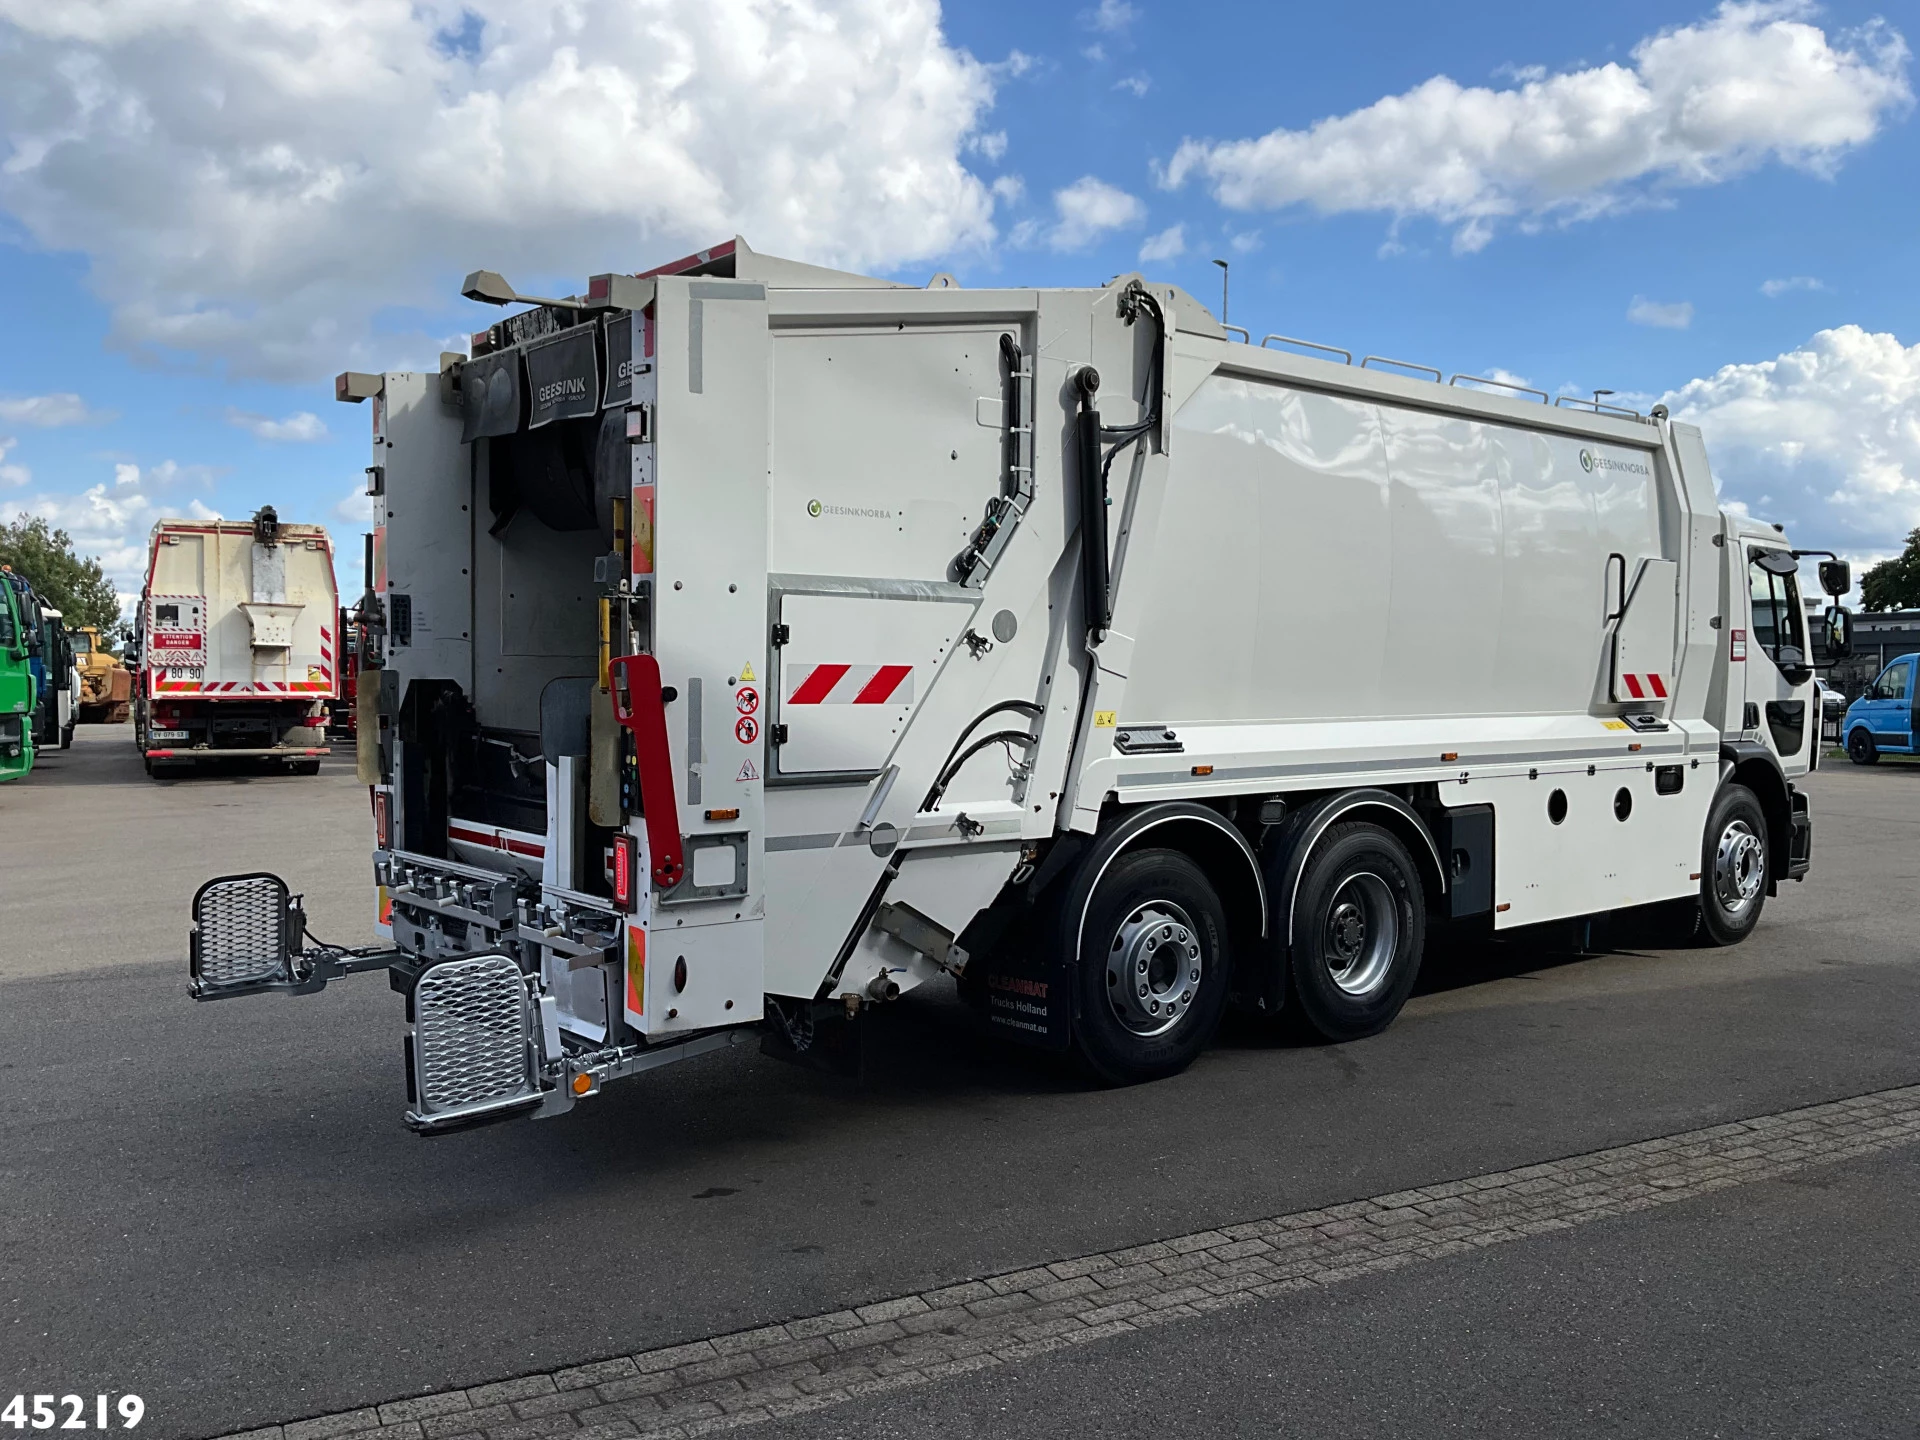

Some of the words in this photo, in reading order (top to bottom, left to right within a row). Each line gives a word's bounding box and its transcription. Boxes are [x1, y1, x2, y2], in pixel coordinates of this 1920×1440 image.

[540, 377, 586, 402] GEESINK
[1593, 457, 1650, 476] GEESINKNORBA
[823, 505, 891, 519] GEESINKNORBA
[171, 667, 183, 679] 80
[189, 668, 201, 679] 90
[988, 975, 1048, 998] CLEANMAT
[990, 995, 1015, 1009] Trucks
[1016, 1000, 1047, 1016] Holland
[991, 1015, 1047, 1033] www.cleanmat.eu
